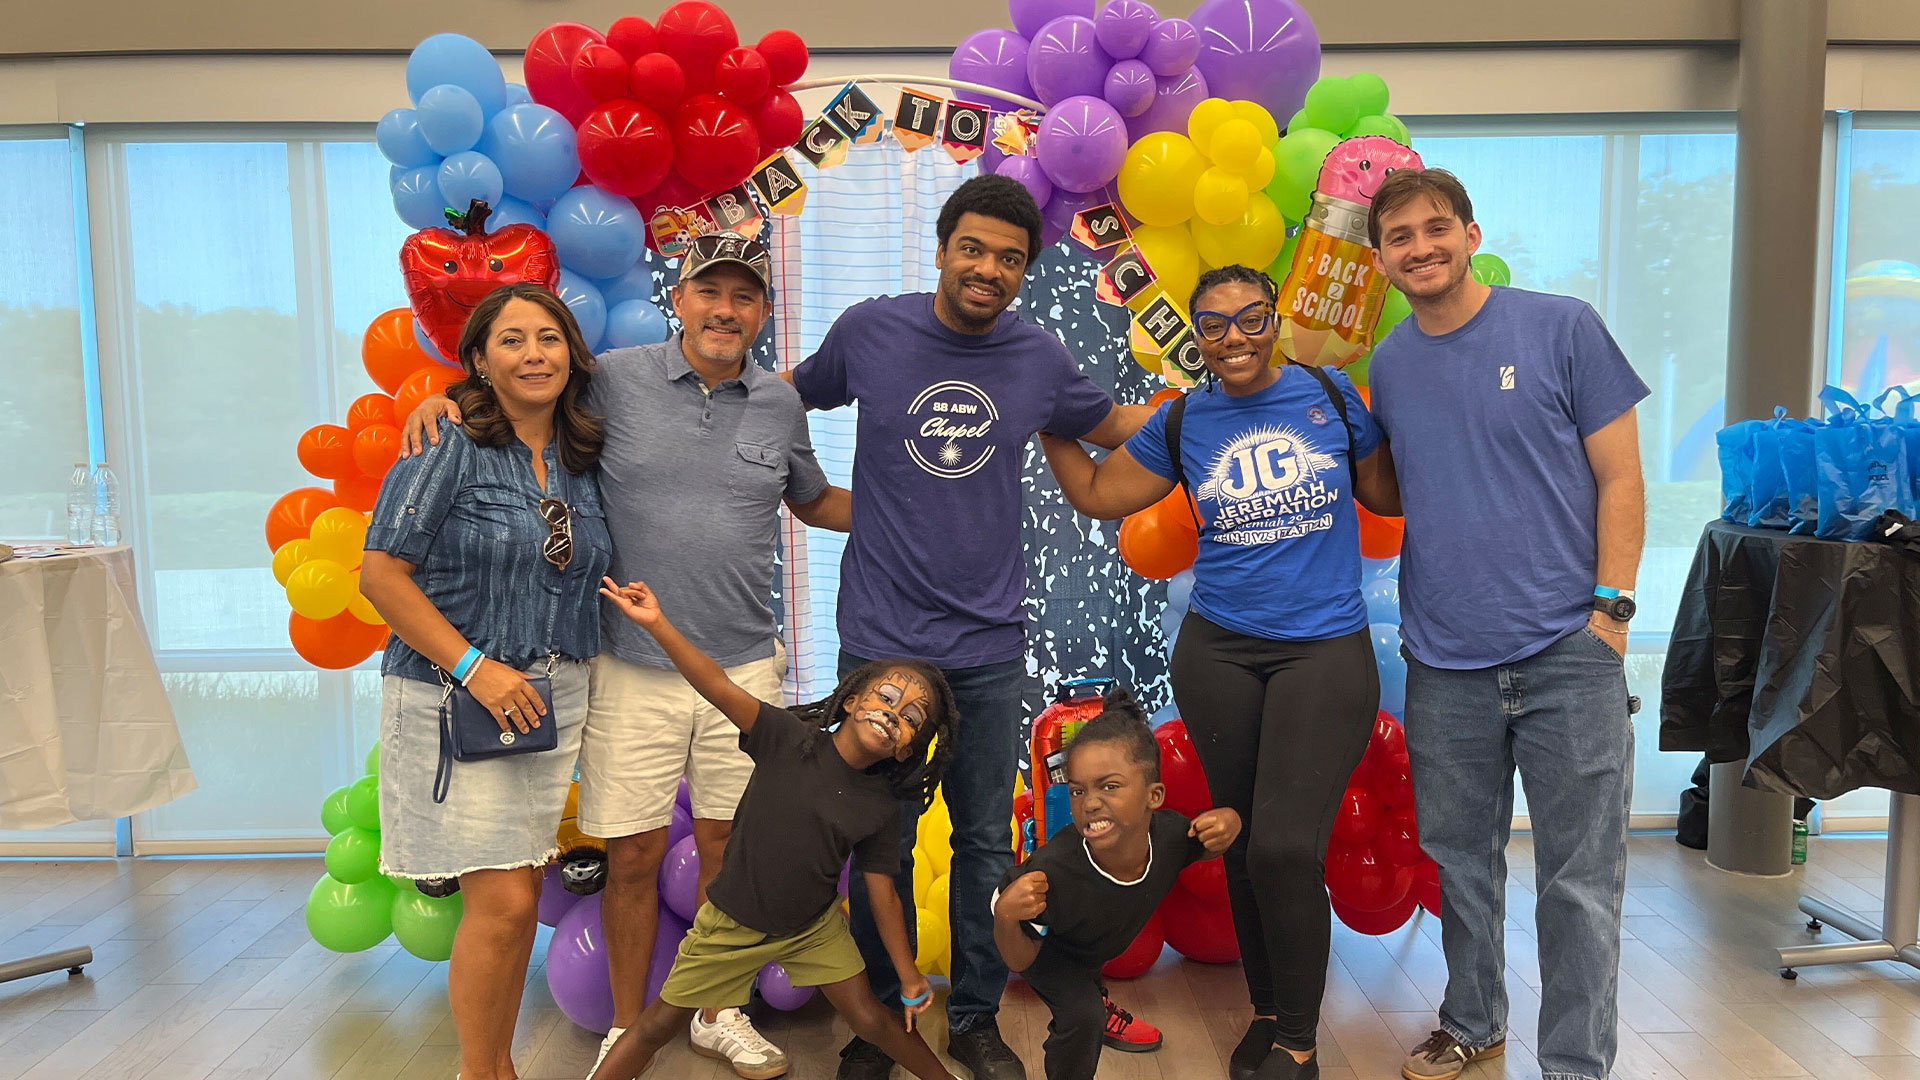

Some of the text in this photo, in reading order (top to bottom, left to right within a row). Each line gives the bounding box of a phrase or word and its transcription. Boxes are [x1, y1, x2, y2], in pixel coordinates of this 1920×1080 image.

[716, 93, 981, 225] BACK TO
[1317, 252, 1370, 288] BACK
[1292, 286, 1366, 330] SCHOOL
[1329, 283, 1343, 299] 2
[932, 401, 978, 415] 88 ABW
[920, 416, 992, 445] Chapel
[1221, 437, 1301, 499] JG
[1213, 488, 1339, 531] GENERATION
[1215, 480, 1326, 521] JEREMIAH
